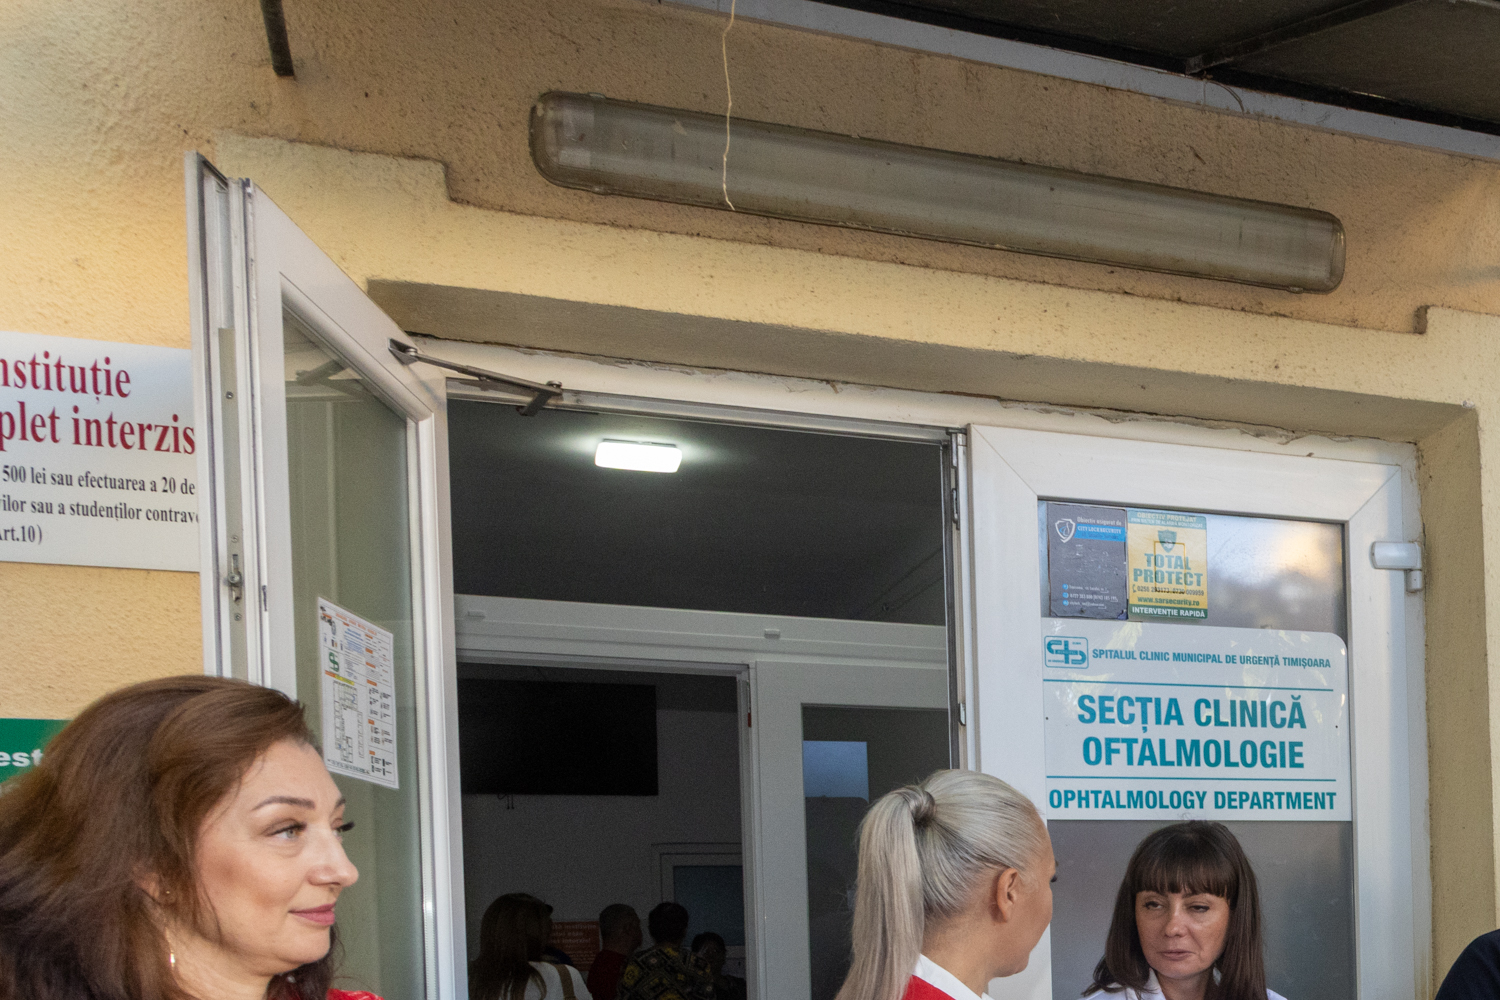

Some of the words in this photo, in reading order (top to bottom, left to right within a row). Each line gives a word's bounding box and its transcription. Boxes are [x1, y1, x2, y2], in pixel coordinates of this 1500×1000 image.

[71, 404, 196, 455] interzis
[2, 464, 27, 483] 500
[30, 466, 47, 485] lei
[50, 472, 74, 487] sau
[77, 470, 146, 492] efectuarea
[150, 480, 157, 492] a
[161, 476, 176, 494] 20
[180, 478, 195, 495] de
[0, 494, 26, 513] ilor
[30, 500, 53, 515] sau
[58, 502, 65, 515] a
[69, 500, 142, 521] studenților
[0, 524, 43, 545] rt.10)
[1144, 553, 1192, 570] TOTAL
[1132, 568, 1204, 587] PROTECT
[1132, 606, 1178, 618] INTERVENȚIE
[1179, 609, 1206, 618] RAPIDĂ
[1092, 648, 1137, 660] SPITALUL
[1139, 650, 1170, 662] CLINIC
[1172, 652, 1223, 664] MUNICIPAL
[1225, 654, 1237, 664] DE
[1240, 655, 1280, 668] URGENȚĂ
[1282, 657, 1331, 669] TIMIȘOARA
[1077, 694, 1184, 733] SECȚIA
[1194, 694, 1307, 729] CLINICĂ
[1082, 736, 1304, 768] OFTALMOLOGIE
[1049, 789, 1207, 810] OPHTALMOLOGY
[1214, 791, 1336, 811] DEPARTMENT
